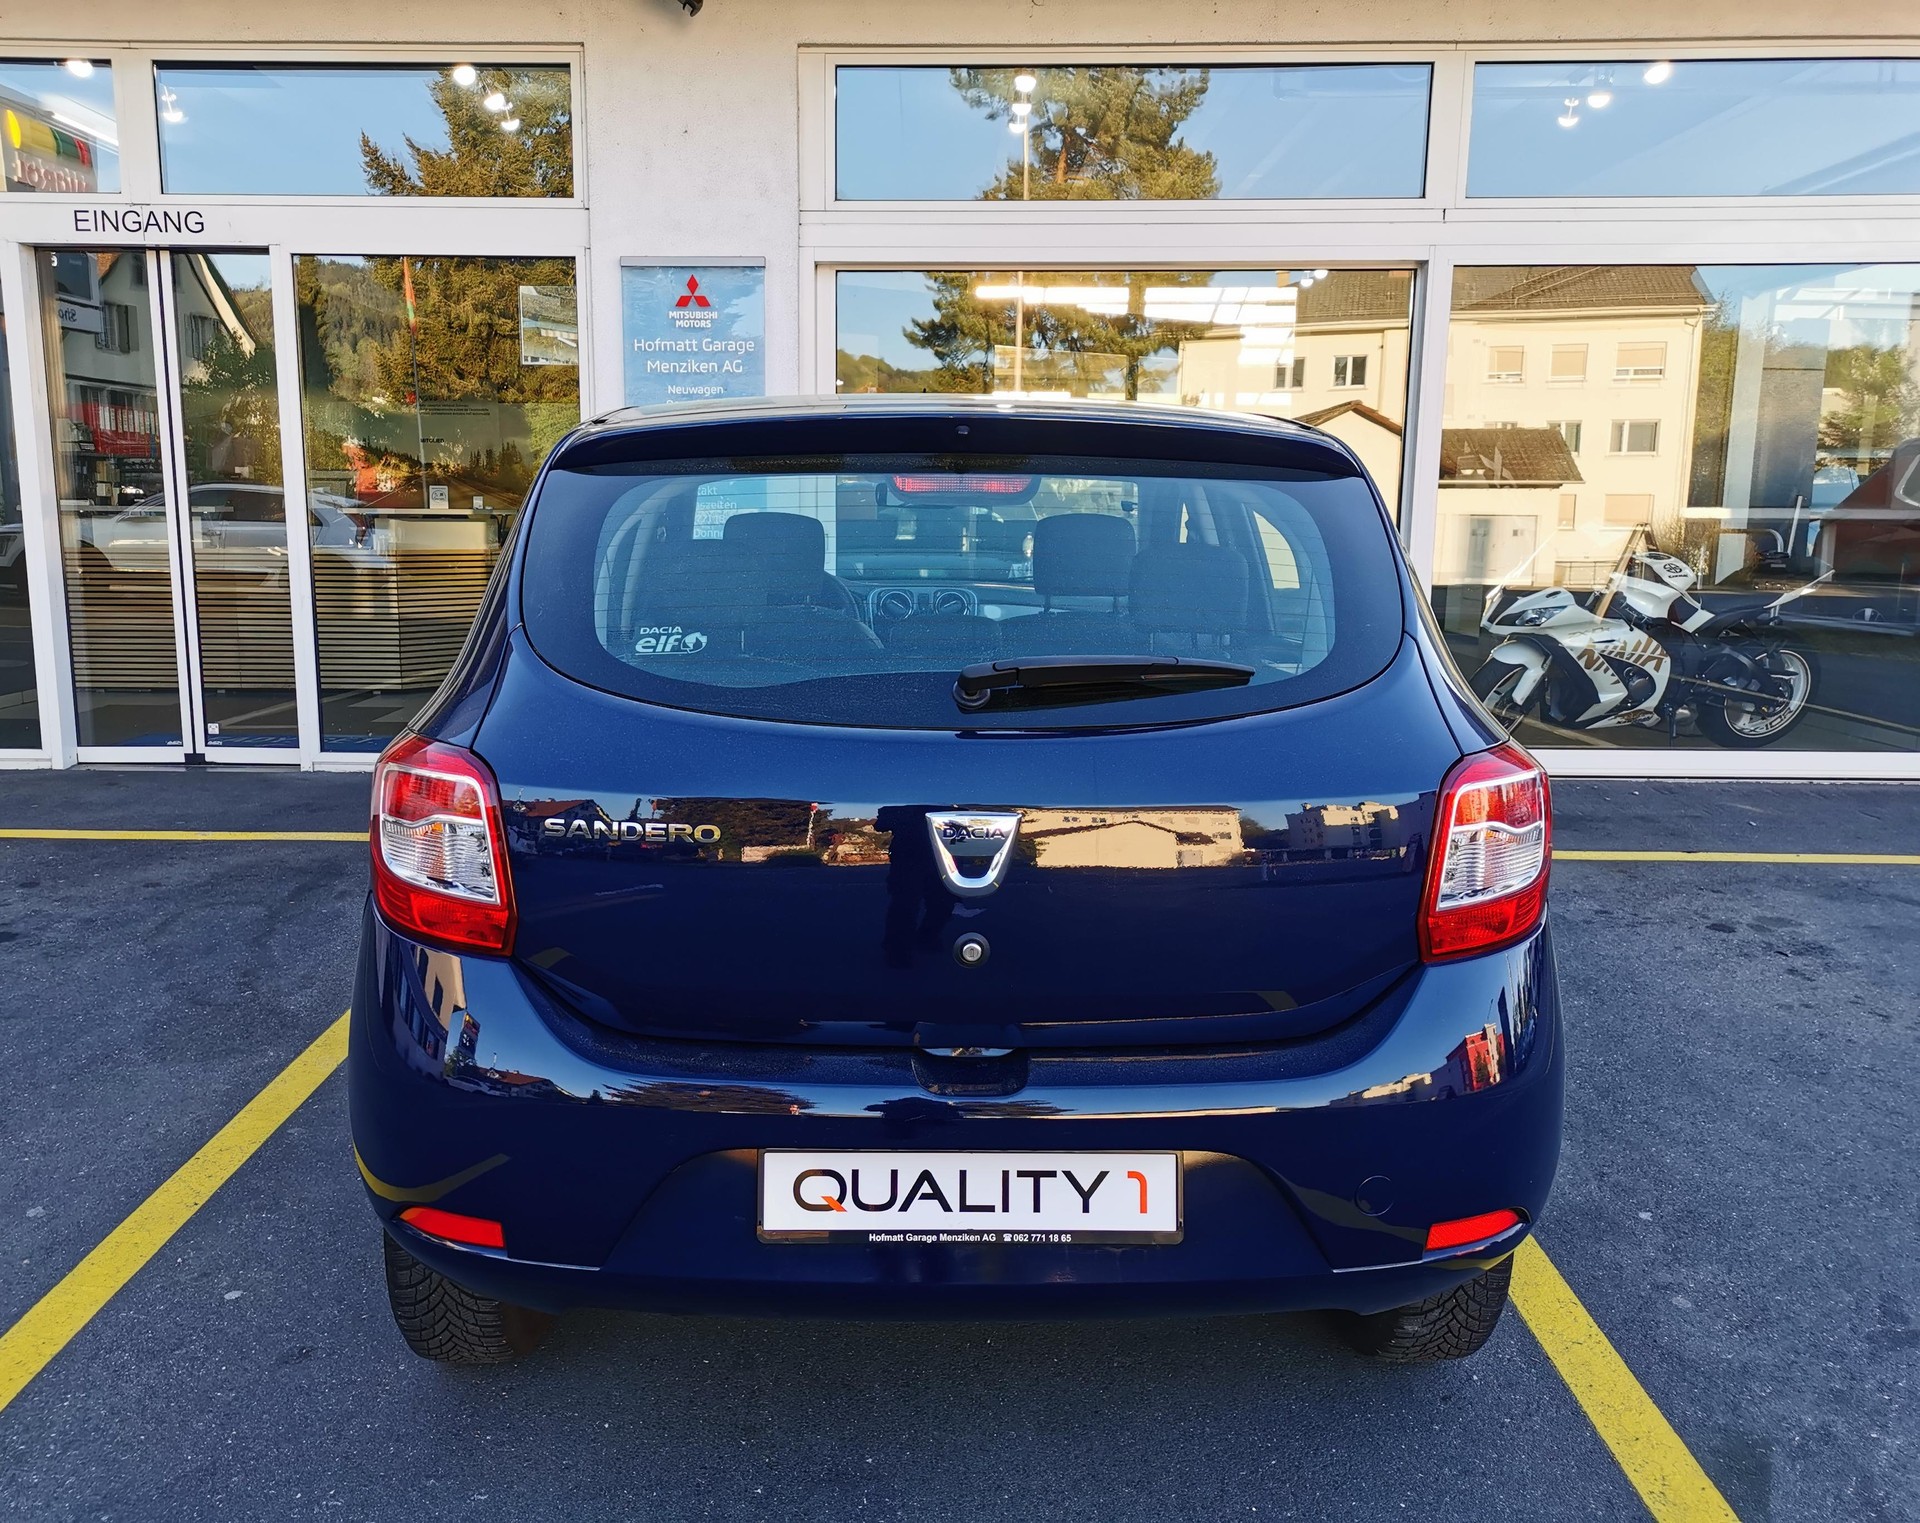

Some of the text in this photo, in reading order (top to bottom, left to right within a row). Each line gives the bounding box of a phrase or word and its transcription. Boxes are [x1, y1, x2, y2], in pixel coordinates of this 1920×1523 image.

[73, 209, 205, 233] EINGANG
[668, 311, 718, 319] MITSUBISHI
[675, 320, 712, 328] MOTORS
[634, 338, 755, 354] Hofmatt Garage
[647, 359, 743, 373] Menziken AG
[667, 385, 724, 397] Neuwagen
[640, 626, 682, 634] DACIA
[635, 635, 682, 653] elf
[544, 817, 722, 844] SANDERO
[942, 827, 1005, 840] DACIA
[793, 1168, 1148, 1214] QUALITY 1
[868, 1233, 1072, 1243] Hofmatt Garage Menziken AG 062 771 18 65
